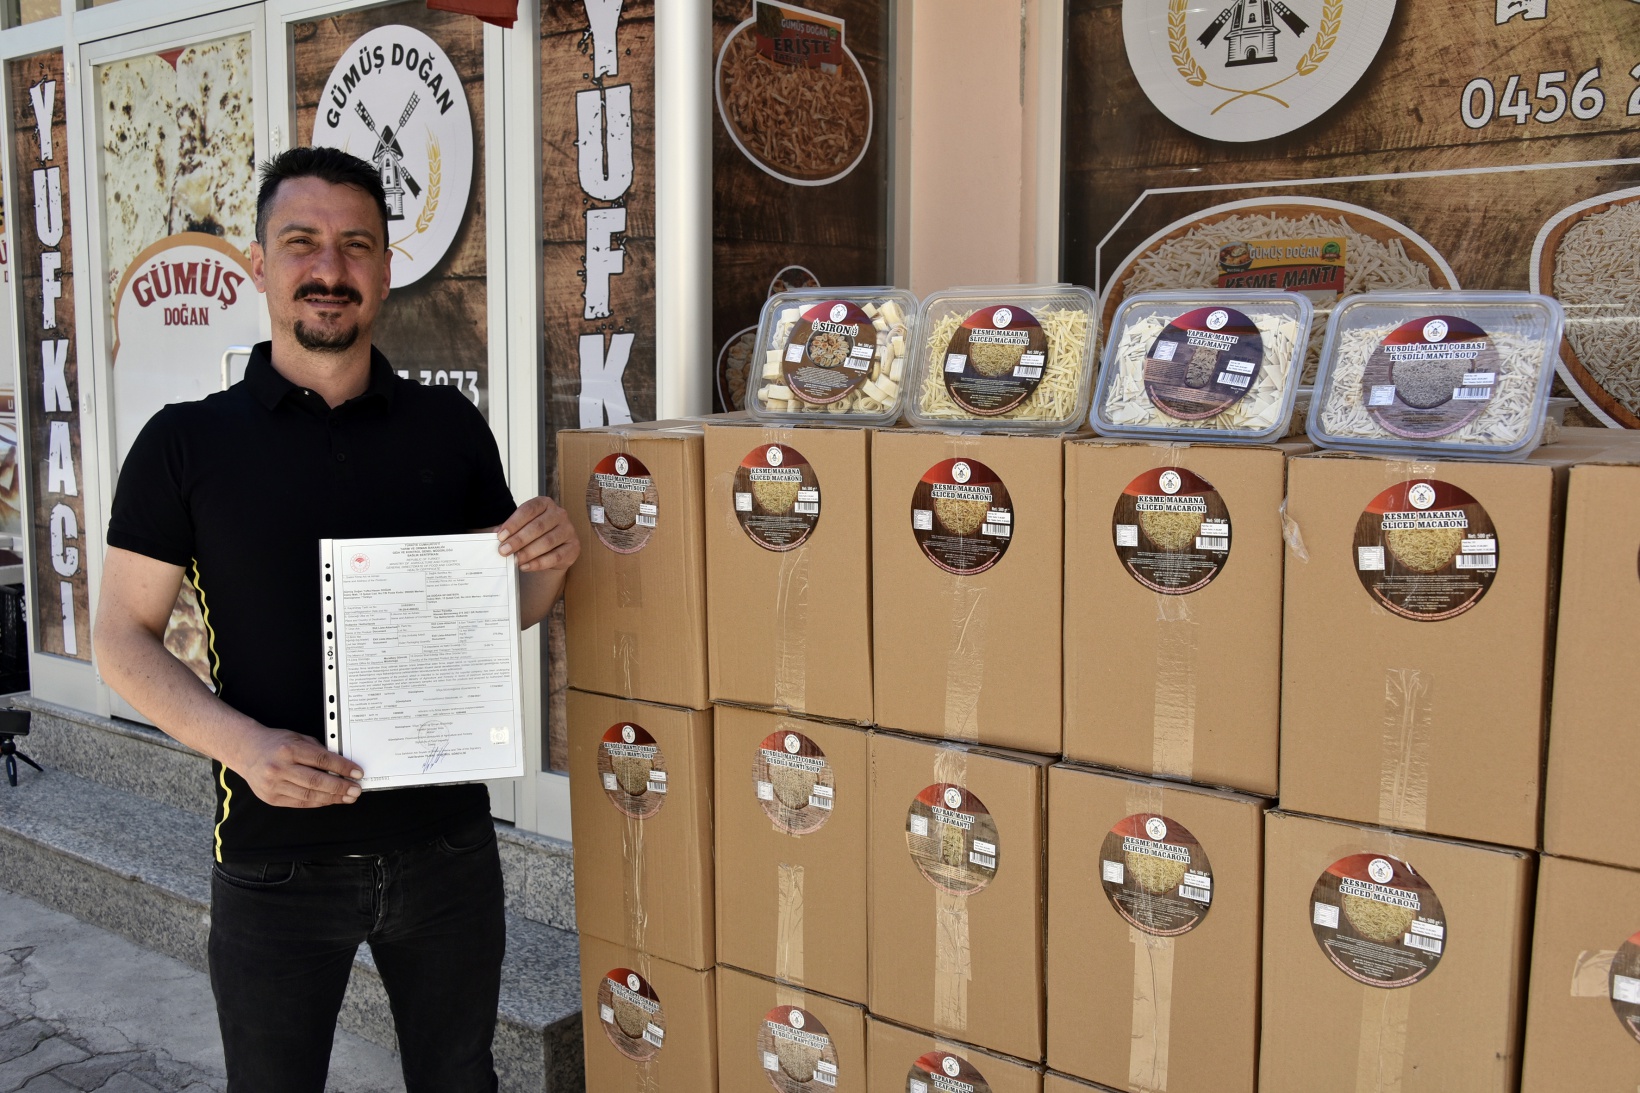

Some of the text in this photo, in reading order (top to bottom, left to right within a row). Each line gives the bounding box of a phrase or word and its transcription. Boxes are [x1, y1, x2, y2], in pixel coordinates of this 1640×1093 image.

[773, 33, 831, 61] ERİŞTE
[327, 43, 454, 128] GÜMÜŞ DOĞAN
[1461, 66, 1605, 130] 0456
[1249, 244, 1321, 263] GÜMÜŞ DOĞAN
[1225, 265, 1339, 289] KESME MANTI
[132, 258, 246, 311] GÜMÜŞ
[163, 303, 210, 326] DOĞAN
[819, 320, 851, 335] SİRON
[993, 337, 1029, 345] MACARONI
[1187, 330, 1238, 344] YAPRAK MANTI
[1207, 340, 1231, 350] MANTI
[1385, 343, 1418, 353] KUŞDİLİ
[1449, 342, 1486, 352] ÇORBASI
[1391, 351, 1423, 362] KUŞDİLİ
[1426, 352, 1453, 360] MANTI
[30, 79, 81, 656] YUFKACI
[933, 483, 990, 494] KESME MAKARNA
[932, 490, 992, 502] SLICED MACARONI
[1138, 495, 1204, 504] KESME MAKARNA
[1165, 504, 1207, 513] MACARONI
[1384, 511, 1464, 520] KESME MAKARNA
[1382, 520, 1467, 530] SLICED MACARONI
[955, 811, 974, 823] MANTI
[950, 819, 970, 830] MANTI
[1125, 836, 1188, 855] KESME MAKARNA
[1123, 844, 1190, 863] SLICED MACARONI
[1343, 877, 1418, 901] KESME MAKARNA
[1340, 886, 1420, 910] SLICED MACARONI
